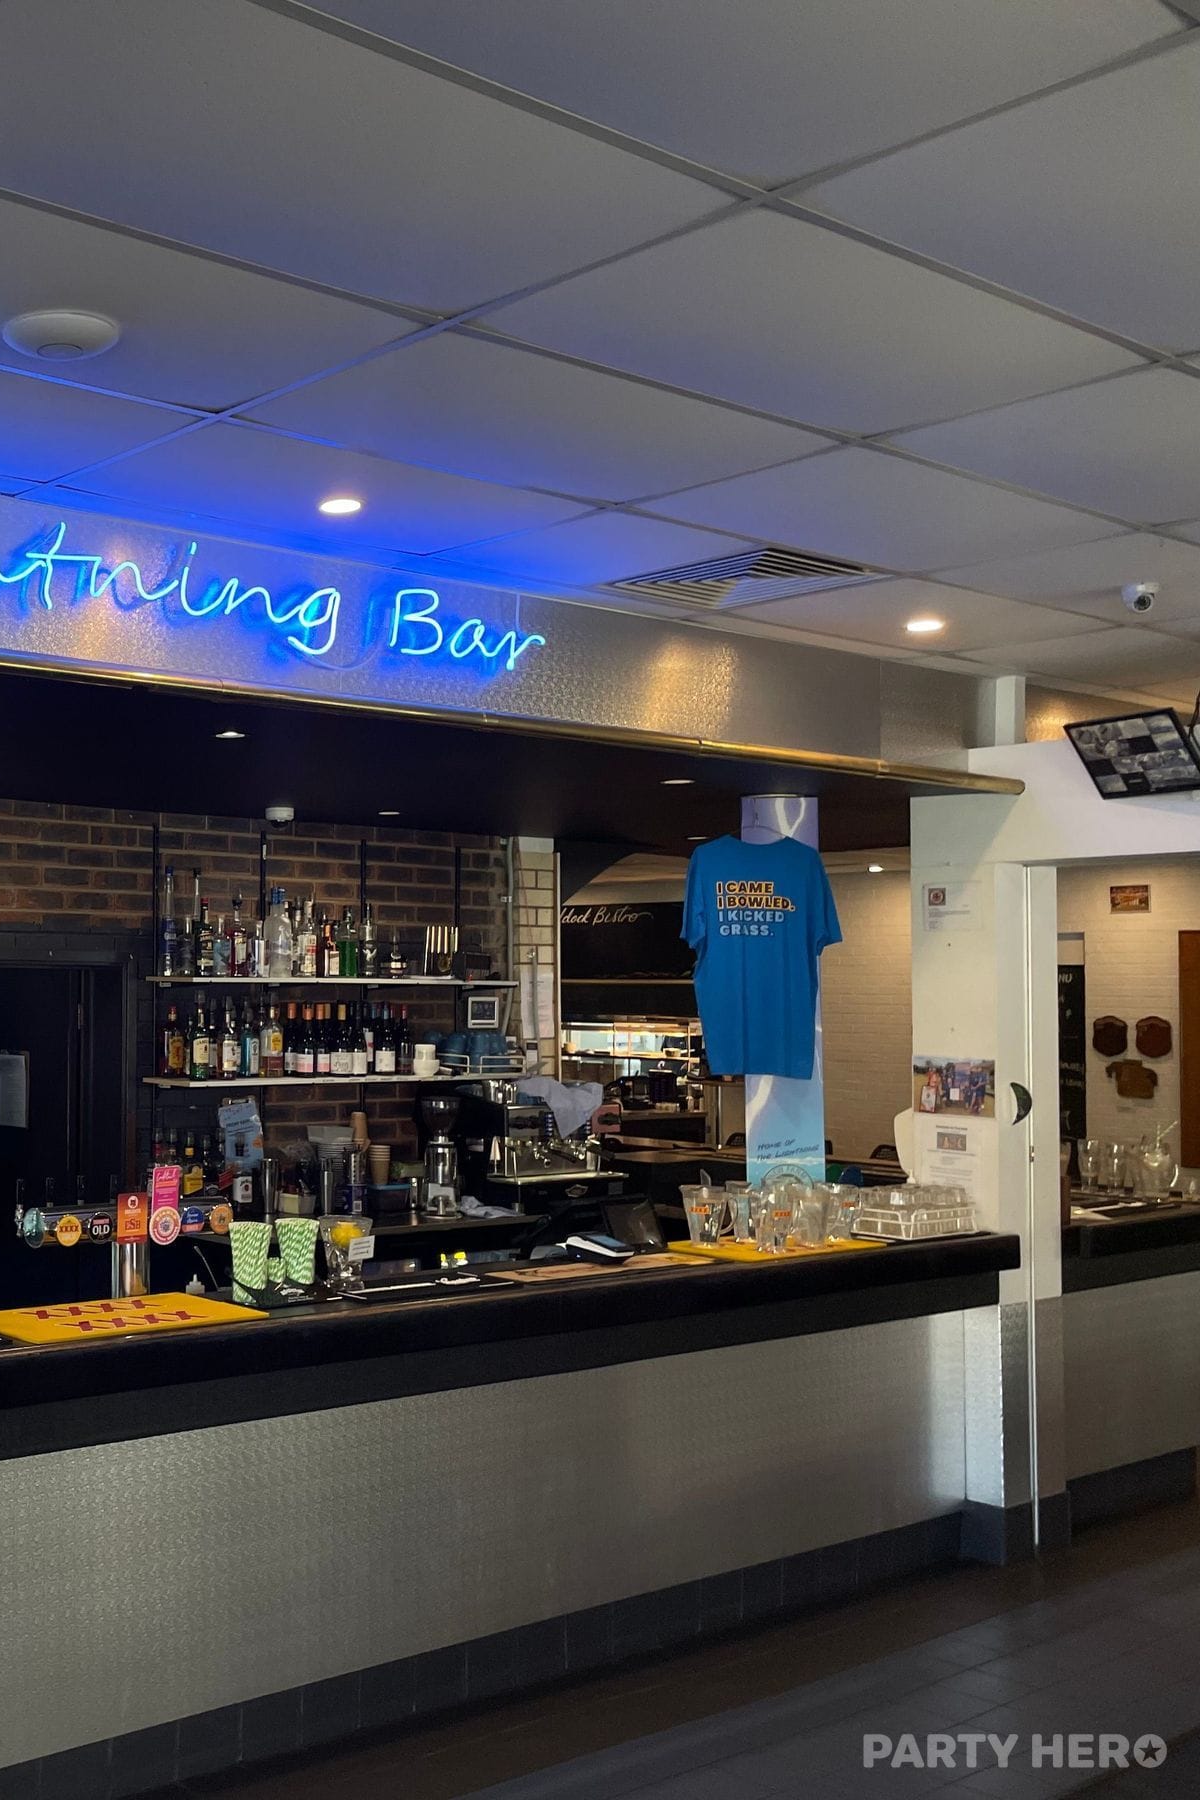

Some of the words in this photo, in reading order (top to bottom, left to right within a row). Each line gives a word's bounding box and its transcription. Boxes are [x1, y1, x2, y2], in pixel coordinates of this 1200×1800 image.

[388, 586, 546, 671] Bar
[716, 881, 723, 894] I
[726, 881, 774, 895] CAME
[718, 895, 724, 908] I
[726, 895, 796, 911] BOWLED.
[592, 906, 654, 926] Bistro
[719, 911, 724, 922] I
[727, 910, 785, 922] KICKED
[719, 924, 775, 937] GRASS.
[59, 1225, 80, 1234] XXXX
[92, 1225, 110, 1237] OLD
